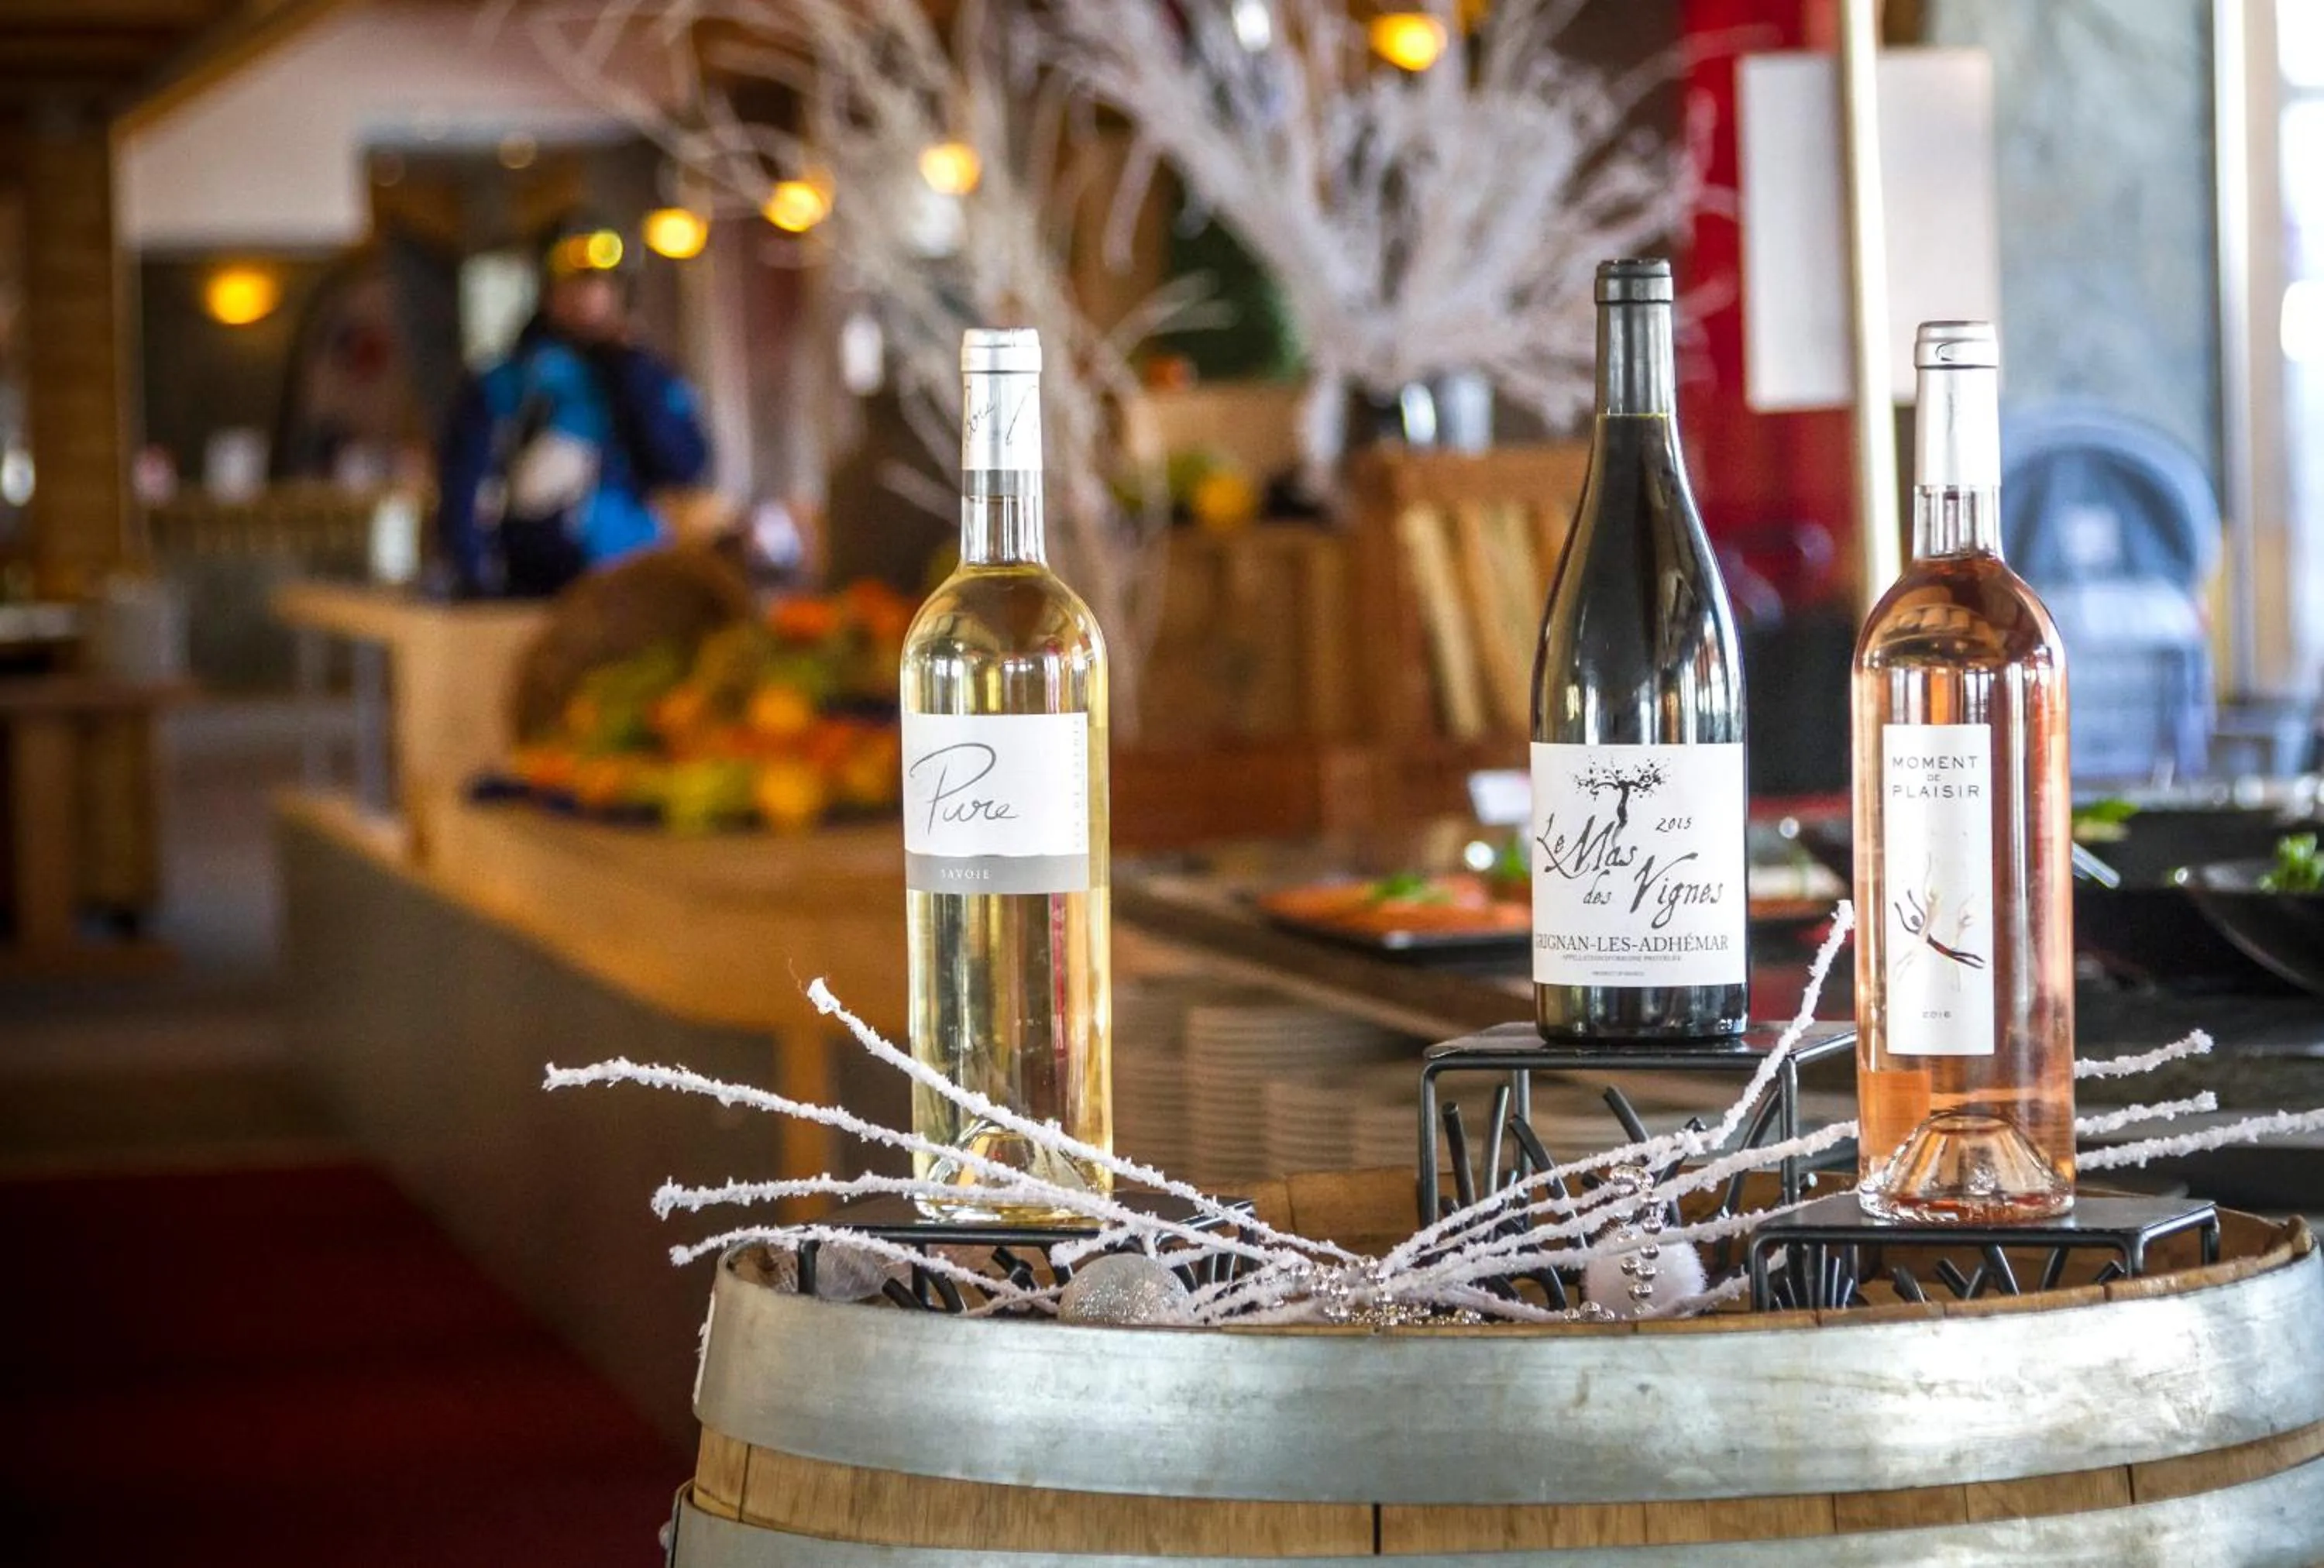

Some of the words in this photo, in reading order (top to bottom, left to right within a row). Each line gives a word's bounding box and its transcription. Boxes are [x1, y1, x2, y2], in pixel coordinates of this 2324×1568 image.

[1892, 755, 1978, 769] MOMENT
[1927, 773, 1942, 782] DE
[909, 741, 1019, 836] Pure
[1892, 784, 1980, 799] PLAISIR
[1655, 816, 1693, 833] 2015
[1536, 813, 1588, 879] Le
[1545, 814, 1638, 873] Mas
[1583, 868, 1611, 905] des
[1629, 852, 1724, 929] Vignes
[1535, 932, 1729, 953] RIGNAN-LES-ADHÉMAR
